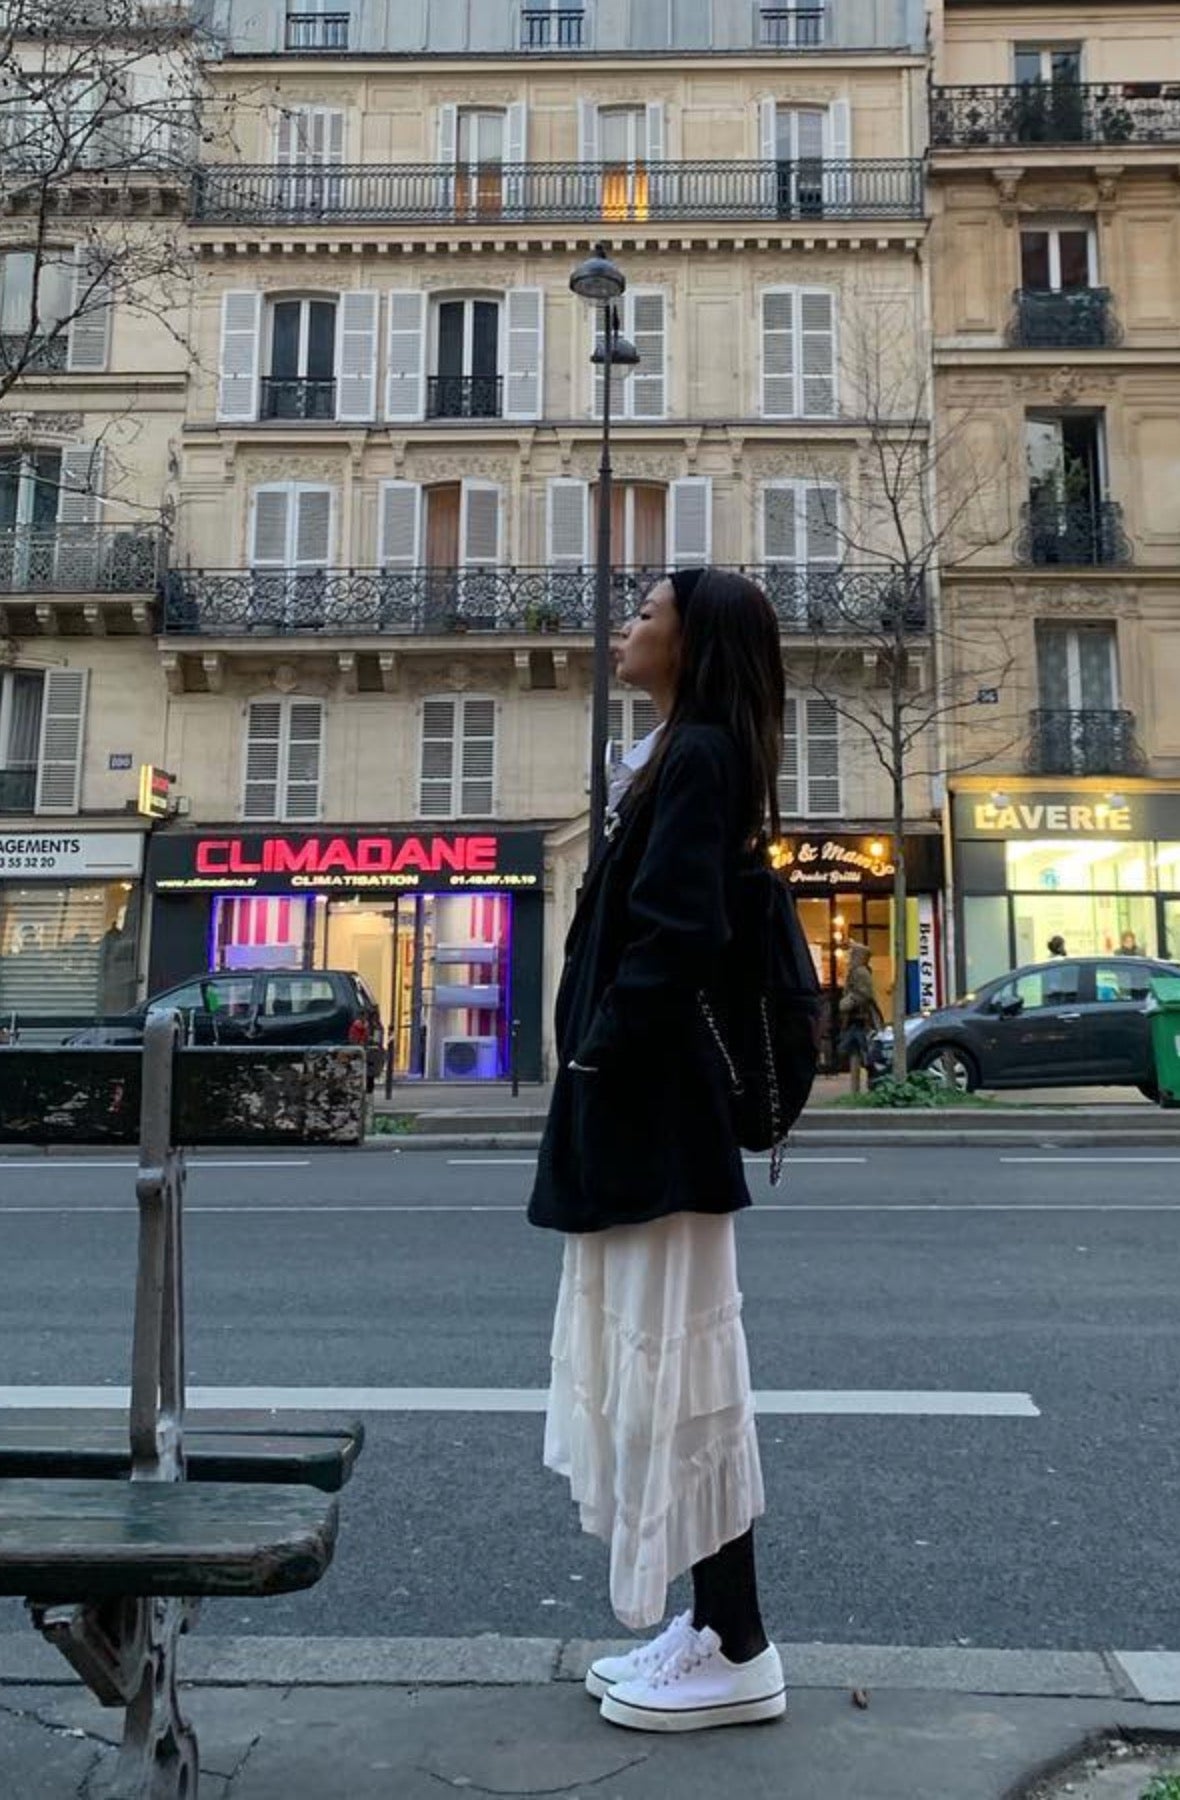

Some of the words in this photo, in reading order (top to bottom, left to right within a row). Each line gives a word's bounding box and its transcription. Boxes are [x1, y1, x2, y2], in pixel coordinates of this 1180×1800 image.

[974, 804, 1132, 830] LAVERIE
[197, 837, 497, 873] CLIMADANE
[798, 842, 818, 862] &
[40, 857, 55, 868] 20
[291, 874, 419, 887] CLIMATISATION
